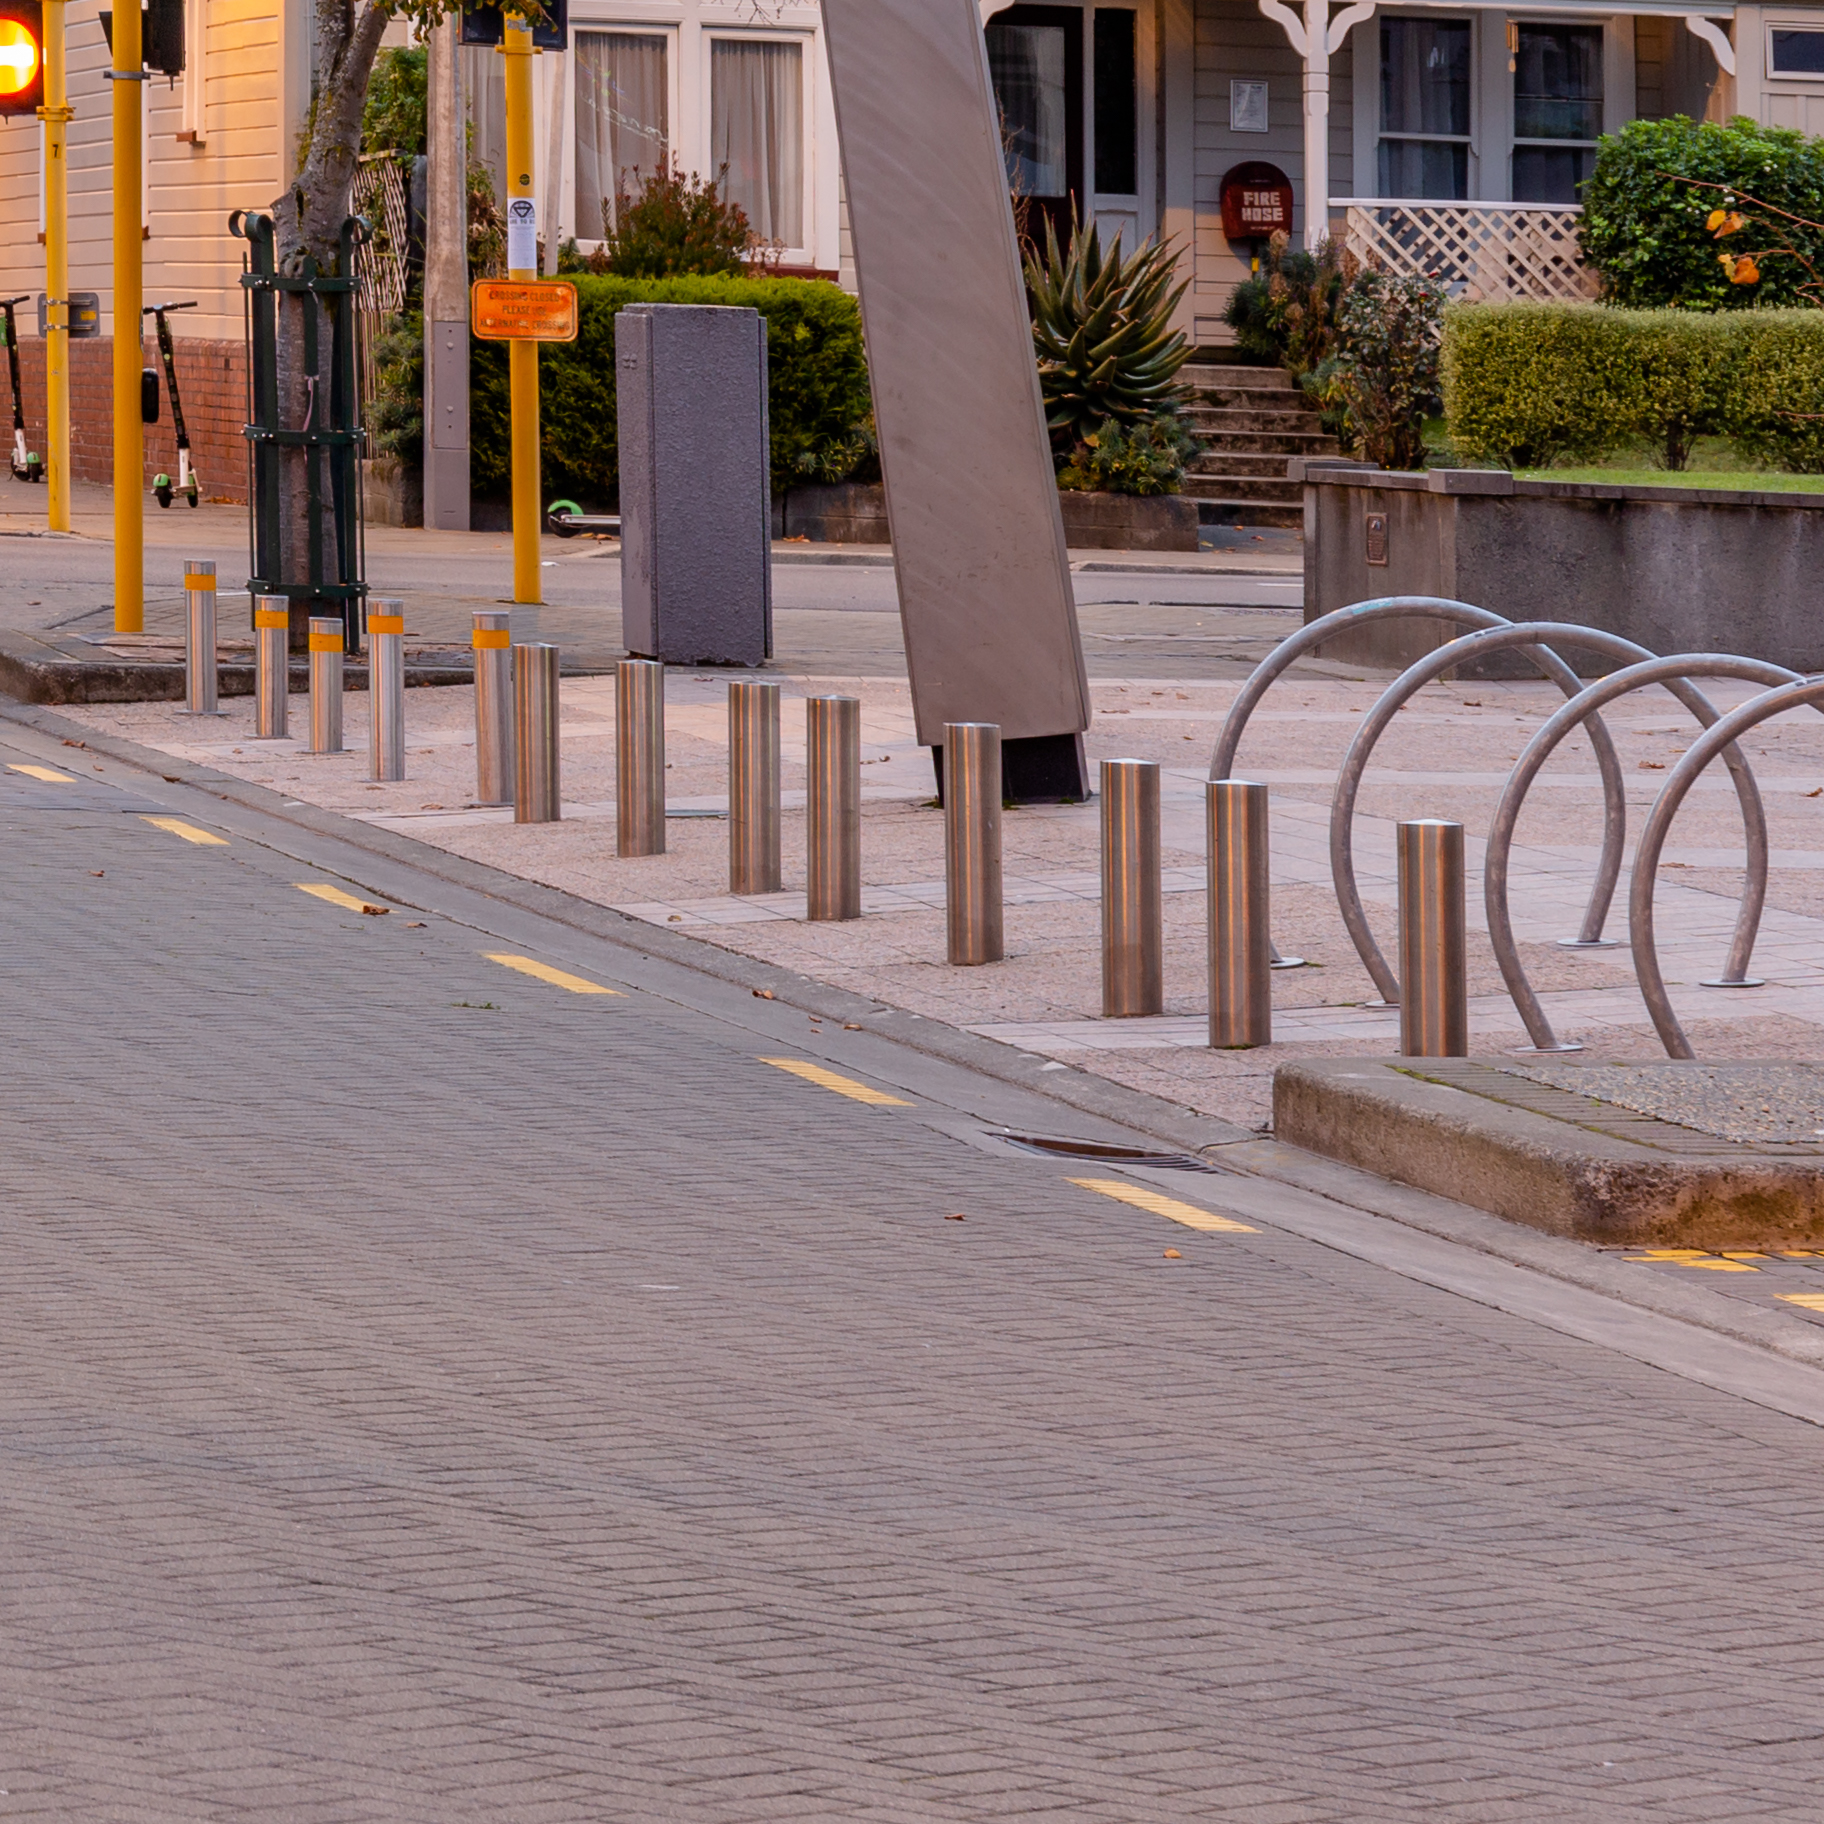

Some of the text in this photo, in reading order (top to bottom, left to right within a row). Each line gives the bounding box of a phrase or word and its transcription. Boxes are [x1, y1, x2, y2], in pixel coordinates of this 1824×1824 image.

[52, 144, 59, 158] 7
[1243, 191, 1281, 206] FIRE
[1241, 207, 1284, 221] HOSE
[490, 290, 559, 302] CROSSING CLOSED
[502, 305, 530, 315] PLEASE
